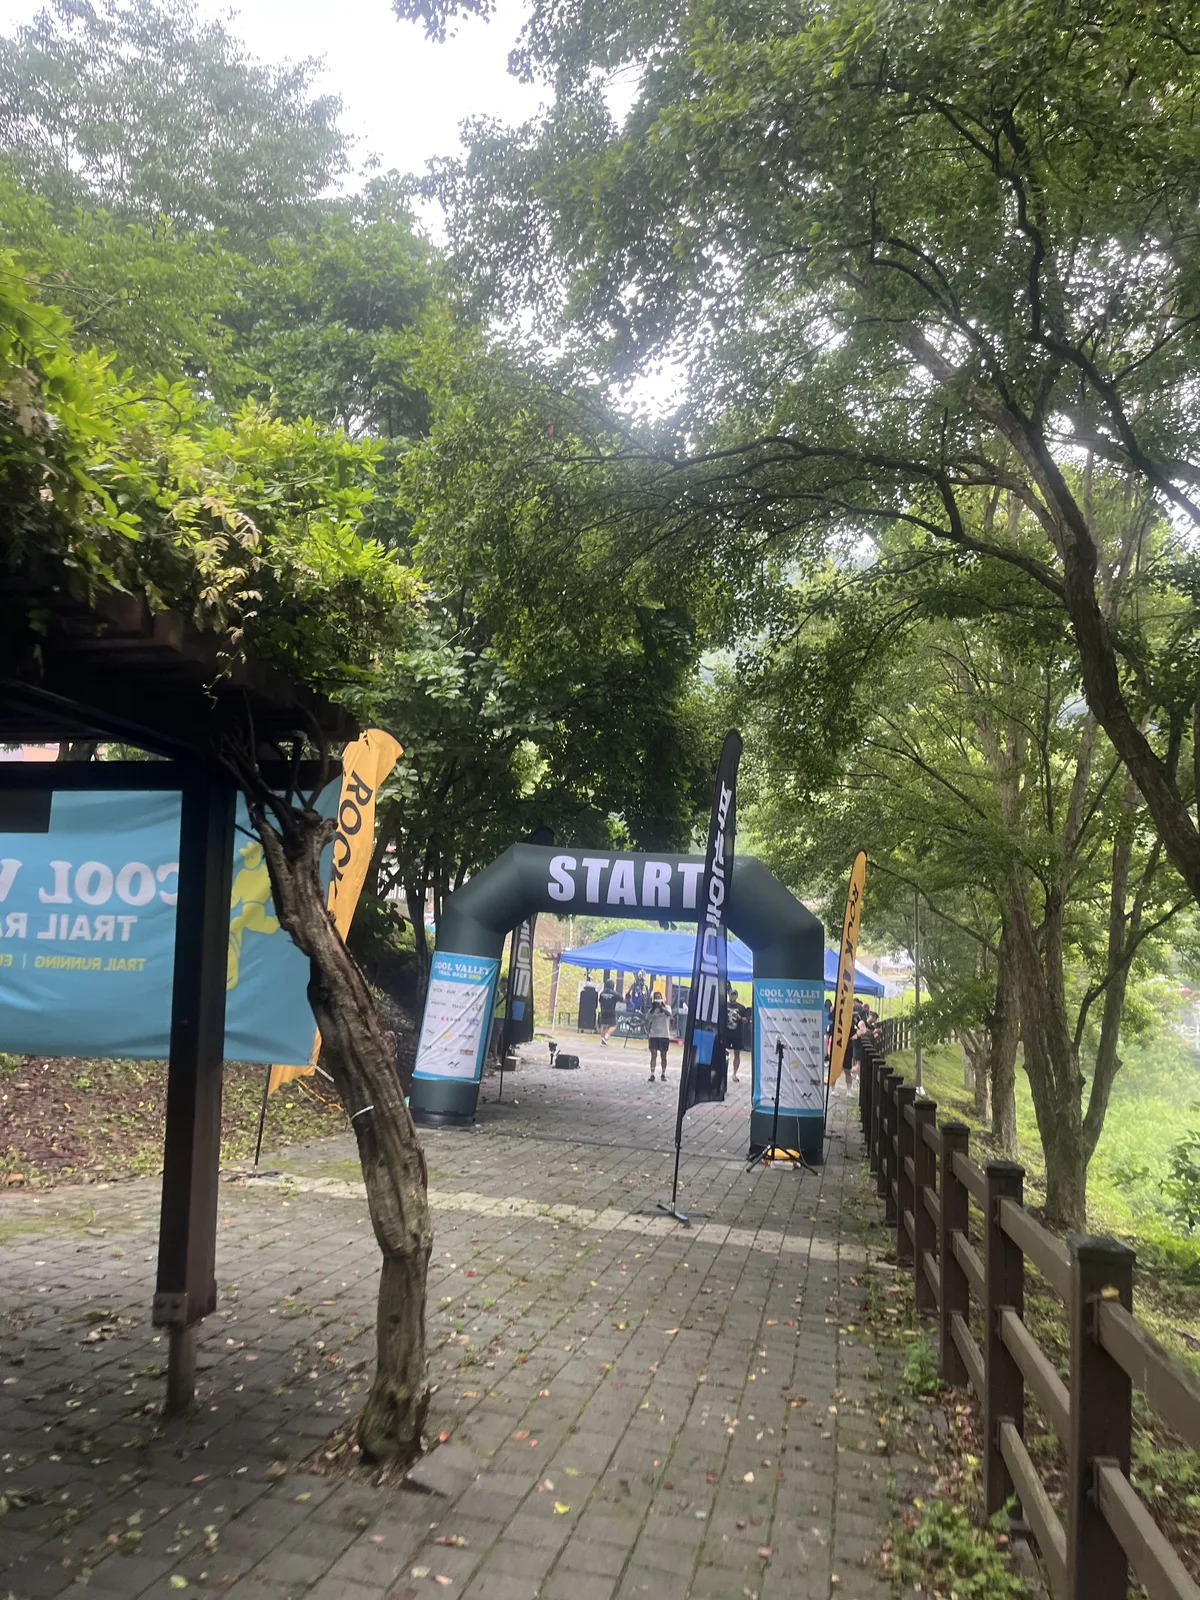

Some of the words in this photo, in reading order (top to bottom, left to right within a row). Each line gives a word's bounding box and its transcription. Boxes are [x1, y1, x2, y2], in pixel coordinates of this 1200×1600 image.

[547, 855, 706, 909] START
[454, 963, 491, 976] VALLEY
[759, 988, 784, 998] COOL
[785, 988, 821, 999] VALLEY
